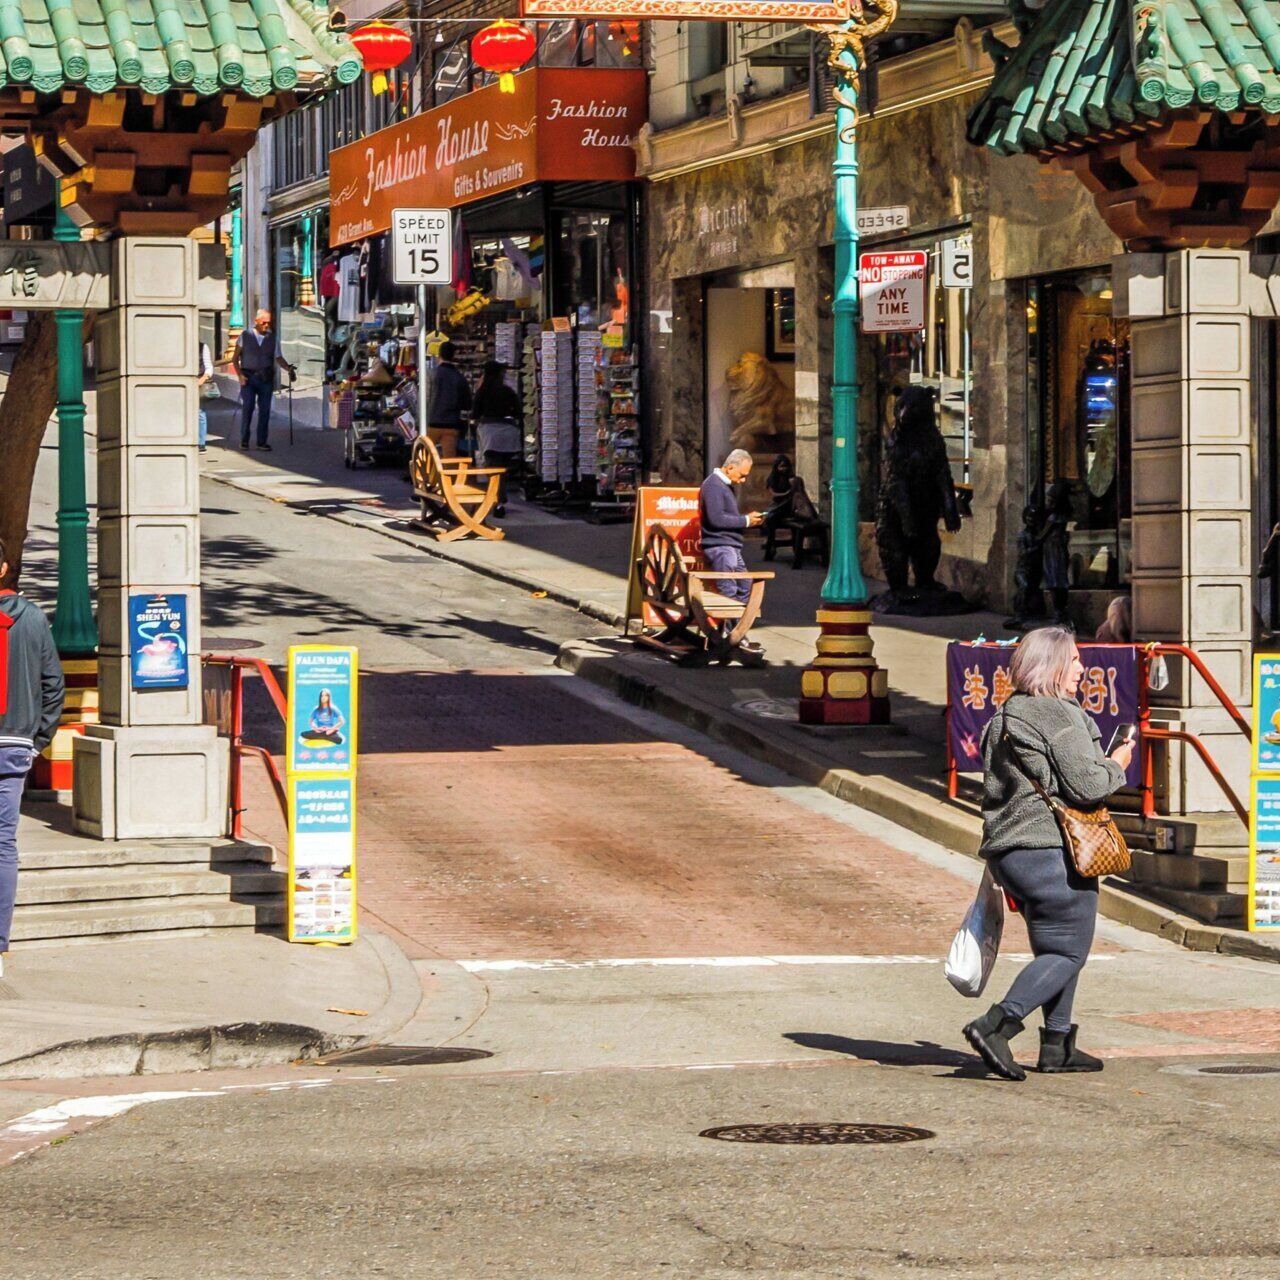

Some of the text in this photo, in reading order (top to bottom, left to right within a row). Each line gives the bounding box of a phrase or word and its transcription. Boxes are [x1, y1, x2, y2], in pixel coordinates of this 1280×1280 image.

[546, 98, 628, 120] Fashion
[581, 128, 630, 147] Hous
[362, 115, 490, 206] Fashion House
[453, 161, 524, 198] Gifts & Souvenirs
[399, 218, 445, 229] SPEED
[404, 233, 440, 244] LIMIT
[408, 249, 440, 275] 15
[870, 255, 916, 266] TOW-AWAY
[862, 266, 924, 282] NO STOPPING
[879, 288, 907, 301] ANY
[877, 302, 910, 315] TIME
[136, 612, 181, 622] SHEN YUN
